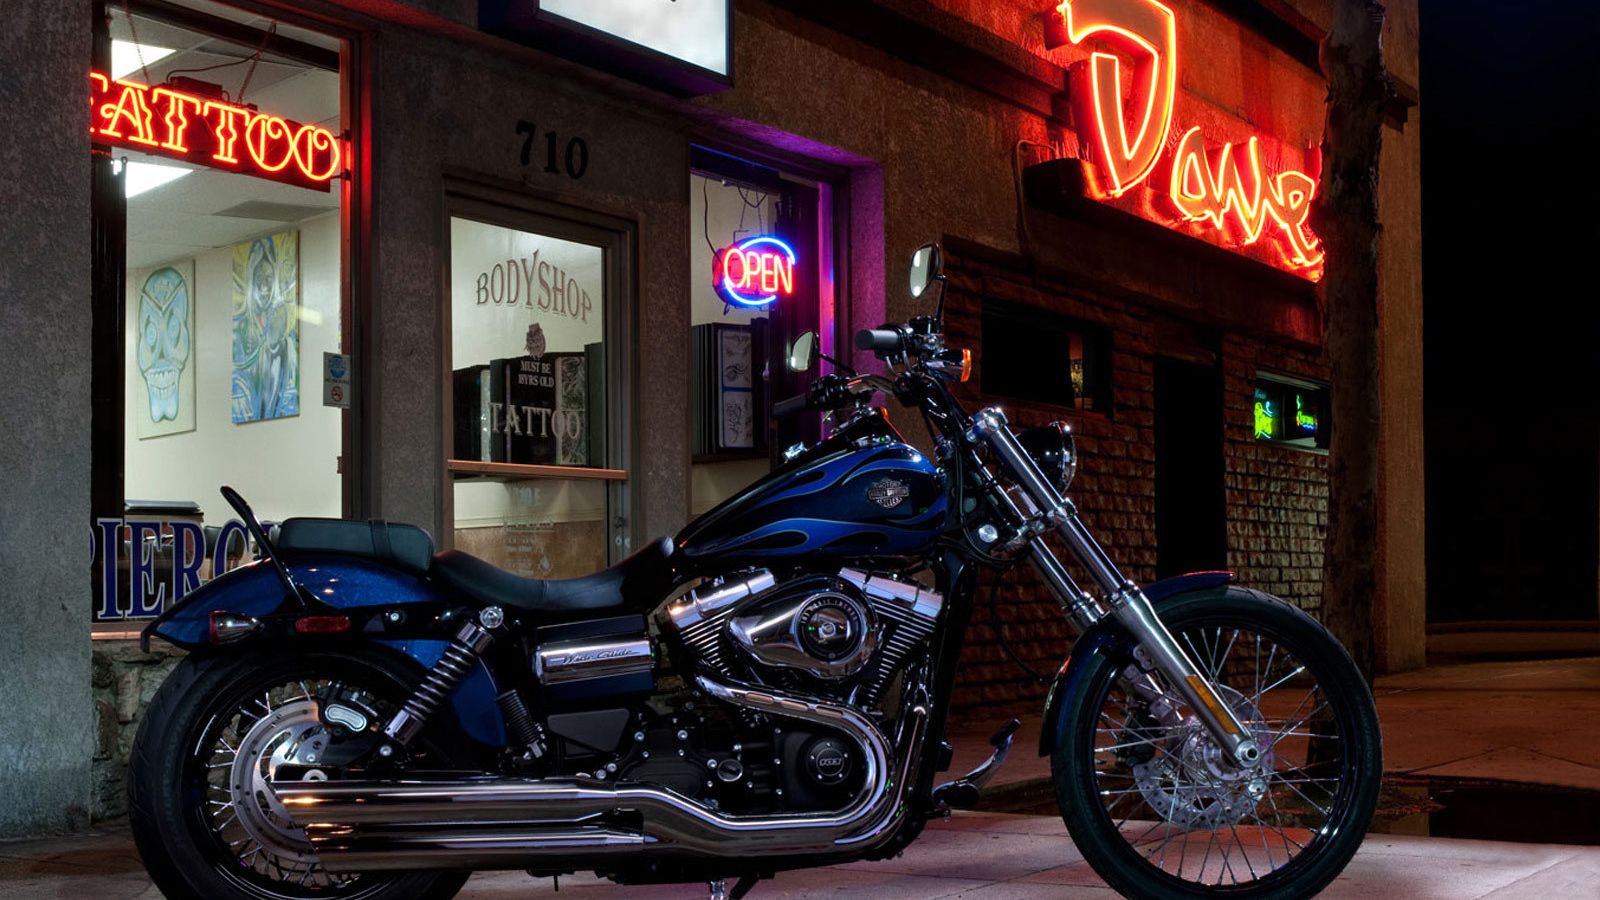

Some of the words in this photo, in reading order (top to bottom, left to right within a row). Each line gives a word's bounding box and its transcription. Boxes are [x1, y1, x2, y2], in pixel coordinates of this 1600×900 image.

[515, 119, 589, 180] 710
[723, 246, 794, 294] OPEN
[520, 360, 540, 373] MUST
[541, 362, 552, 375] BE
[539, 375, 555, 388] OLD
[488, 402, 581, 439] TATTOO
